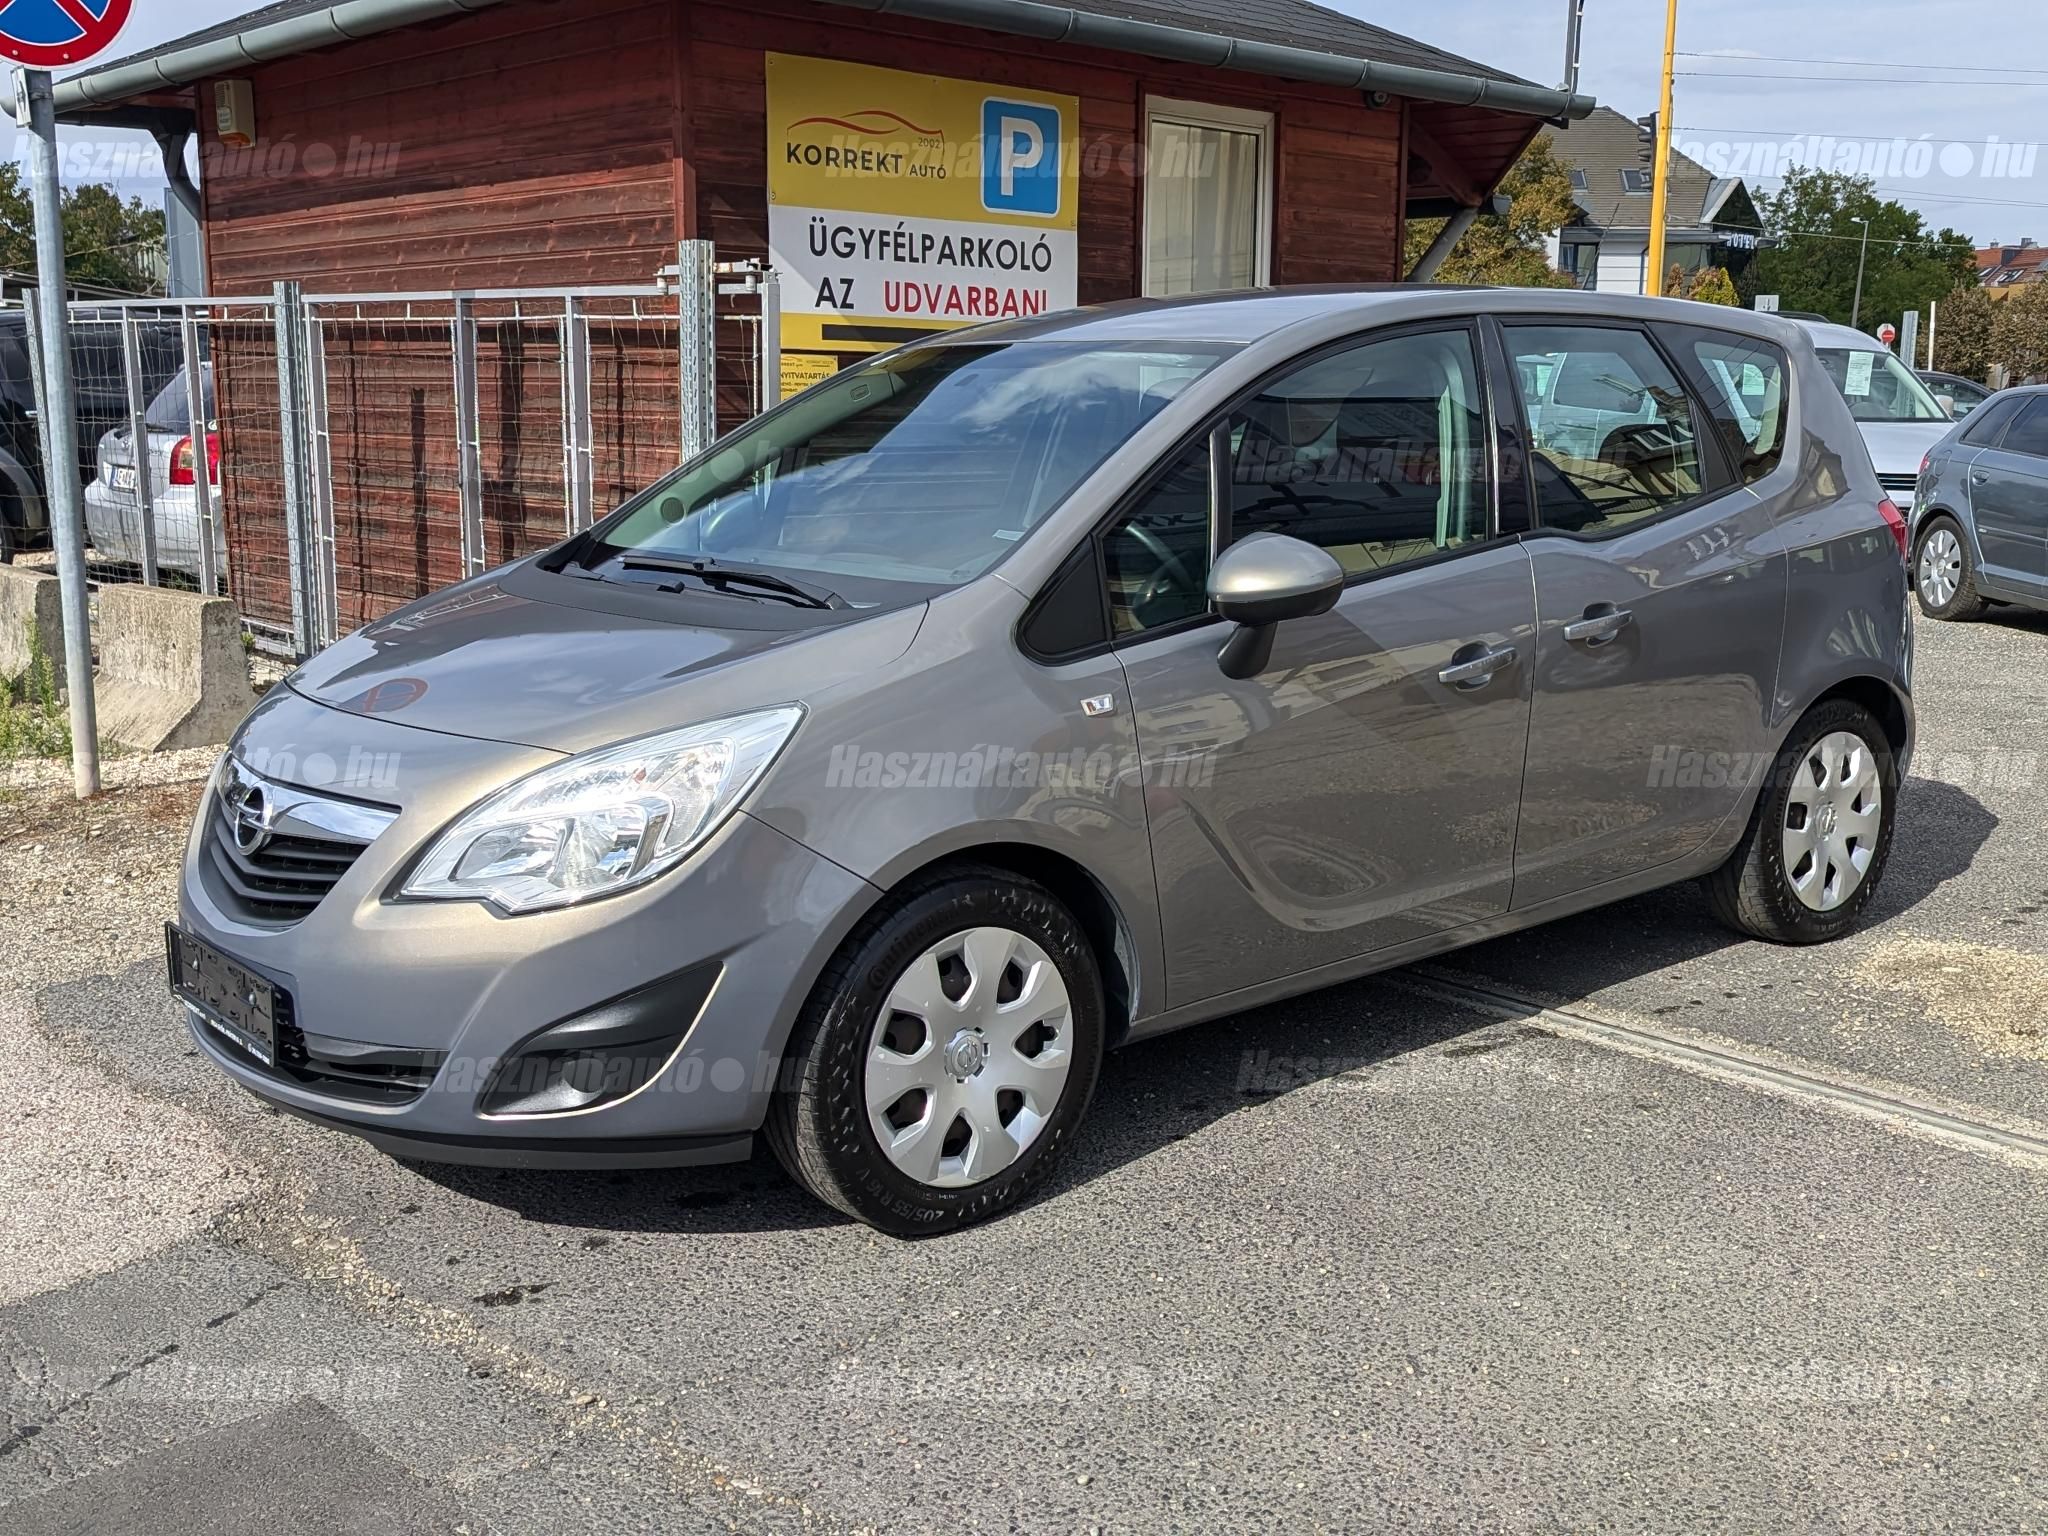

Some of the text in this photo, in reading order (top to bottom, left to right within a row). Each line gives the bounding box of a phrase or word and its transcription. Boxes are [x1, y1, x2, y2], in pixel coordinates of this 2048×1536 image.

[786, 142, 947, 179] KORREKT AUTÓ
[918, 137, 941, 149] 2002
[1000, 115, 1044, 197] P
[809, 216, 1052, 273] ÜGYFÉLPARKOLÓ
[815, 277, 855, 310] AZ
